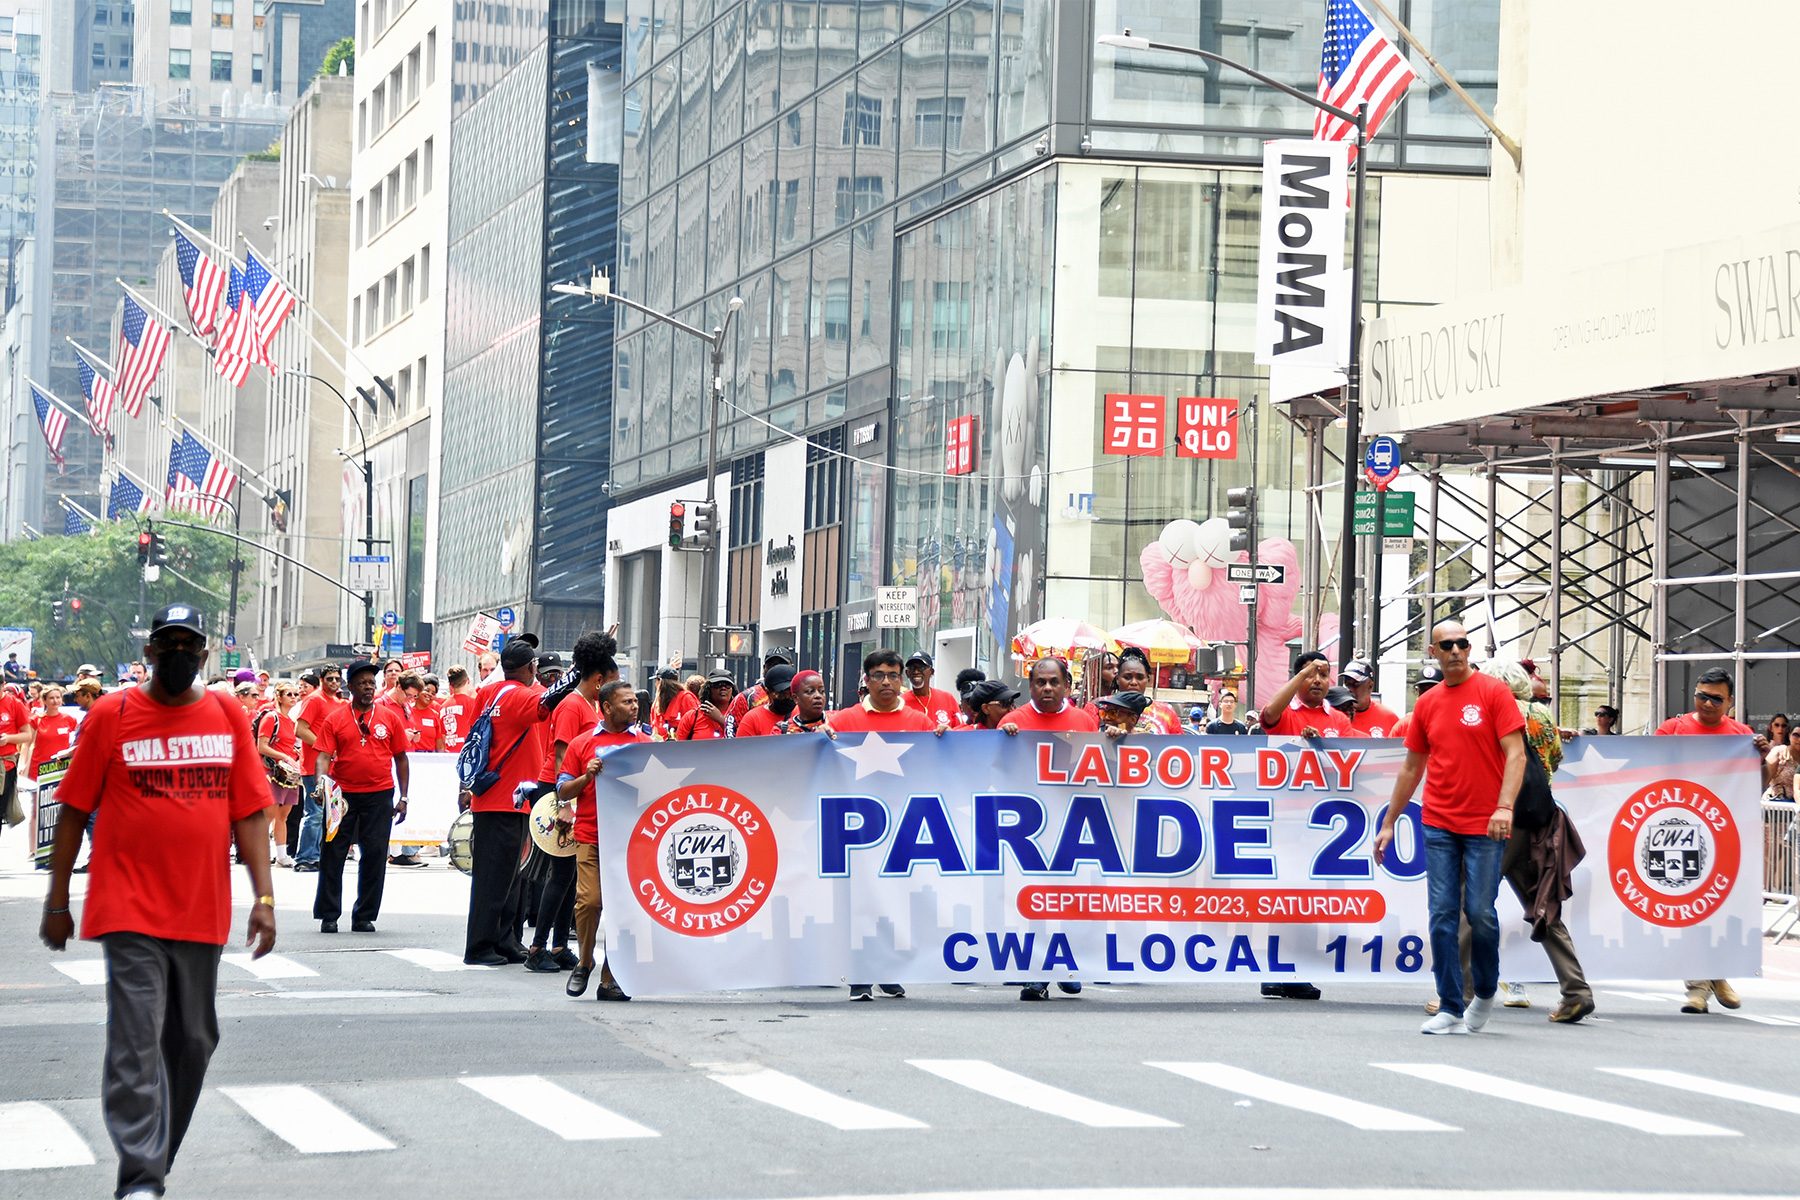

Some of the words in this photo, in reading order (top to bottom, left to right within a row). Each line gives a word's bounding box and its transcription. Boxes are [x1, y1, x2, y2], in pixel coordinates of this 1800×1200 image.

[1273, 154, 1331, 356] MoMA
[1593, 311, 1632, 342] HOLIDAY
[1634, 305, 1656, 336] 2023
[1370, 313, 1504, 412] SWAROVSKI
[1185, 404, 1228, 427] UNI
[1184, 428, 1231, 454] QLO
[1236, 569, 1252, 577] ONE
[1259, 570, 1276, 578] WAY
[878, 602, 916, 612] INTERSECTION
[886, 591, 907, 600] KEEP
[883, 614, 911, 624] CLEAR
[122, 737, 166, 762] CWA
[167, 734, 233, 761] STRONG
[1036, 742, 1237, 789] LABOR
[1256, 748, 1366, 791] DAY
[641, 792, 713, 841] LOCAL
[717, 797, 760, 836] 1182
[1620, 788, 1685, 832] LOCAL
[1688, 792, 1728, 832] 1182
[677, 834, 727, 855] CWA
[818, 792, 1278, 879] PARADE
[1308, 797, 1428, 881] 20
[1652, 829, 1695, 847] CWA
[639, 878, 677, 925] CWA
[681, 878, 765, 930] STRONG
[1030, 891, 1162, 914] SEPTEMBER
[1169, 894, 1187, 917] 9,
[1194, 895, 1250, 918] 2023,
[1257, 896, 1370, 916] SATURDAY
[1616, 867, 1650, 914] CWA
[1652, 873, 1730, 921] STRONG
[942, 932, 1079, 972] CWA
[1106, 933, 1296, 973] LOCAL
[1325, 934, 1432, 973] 118
